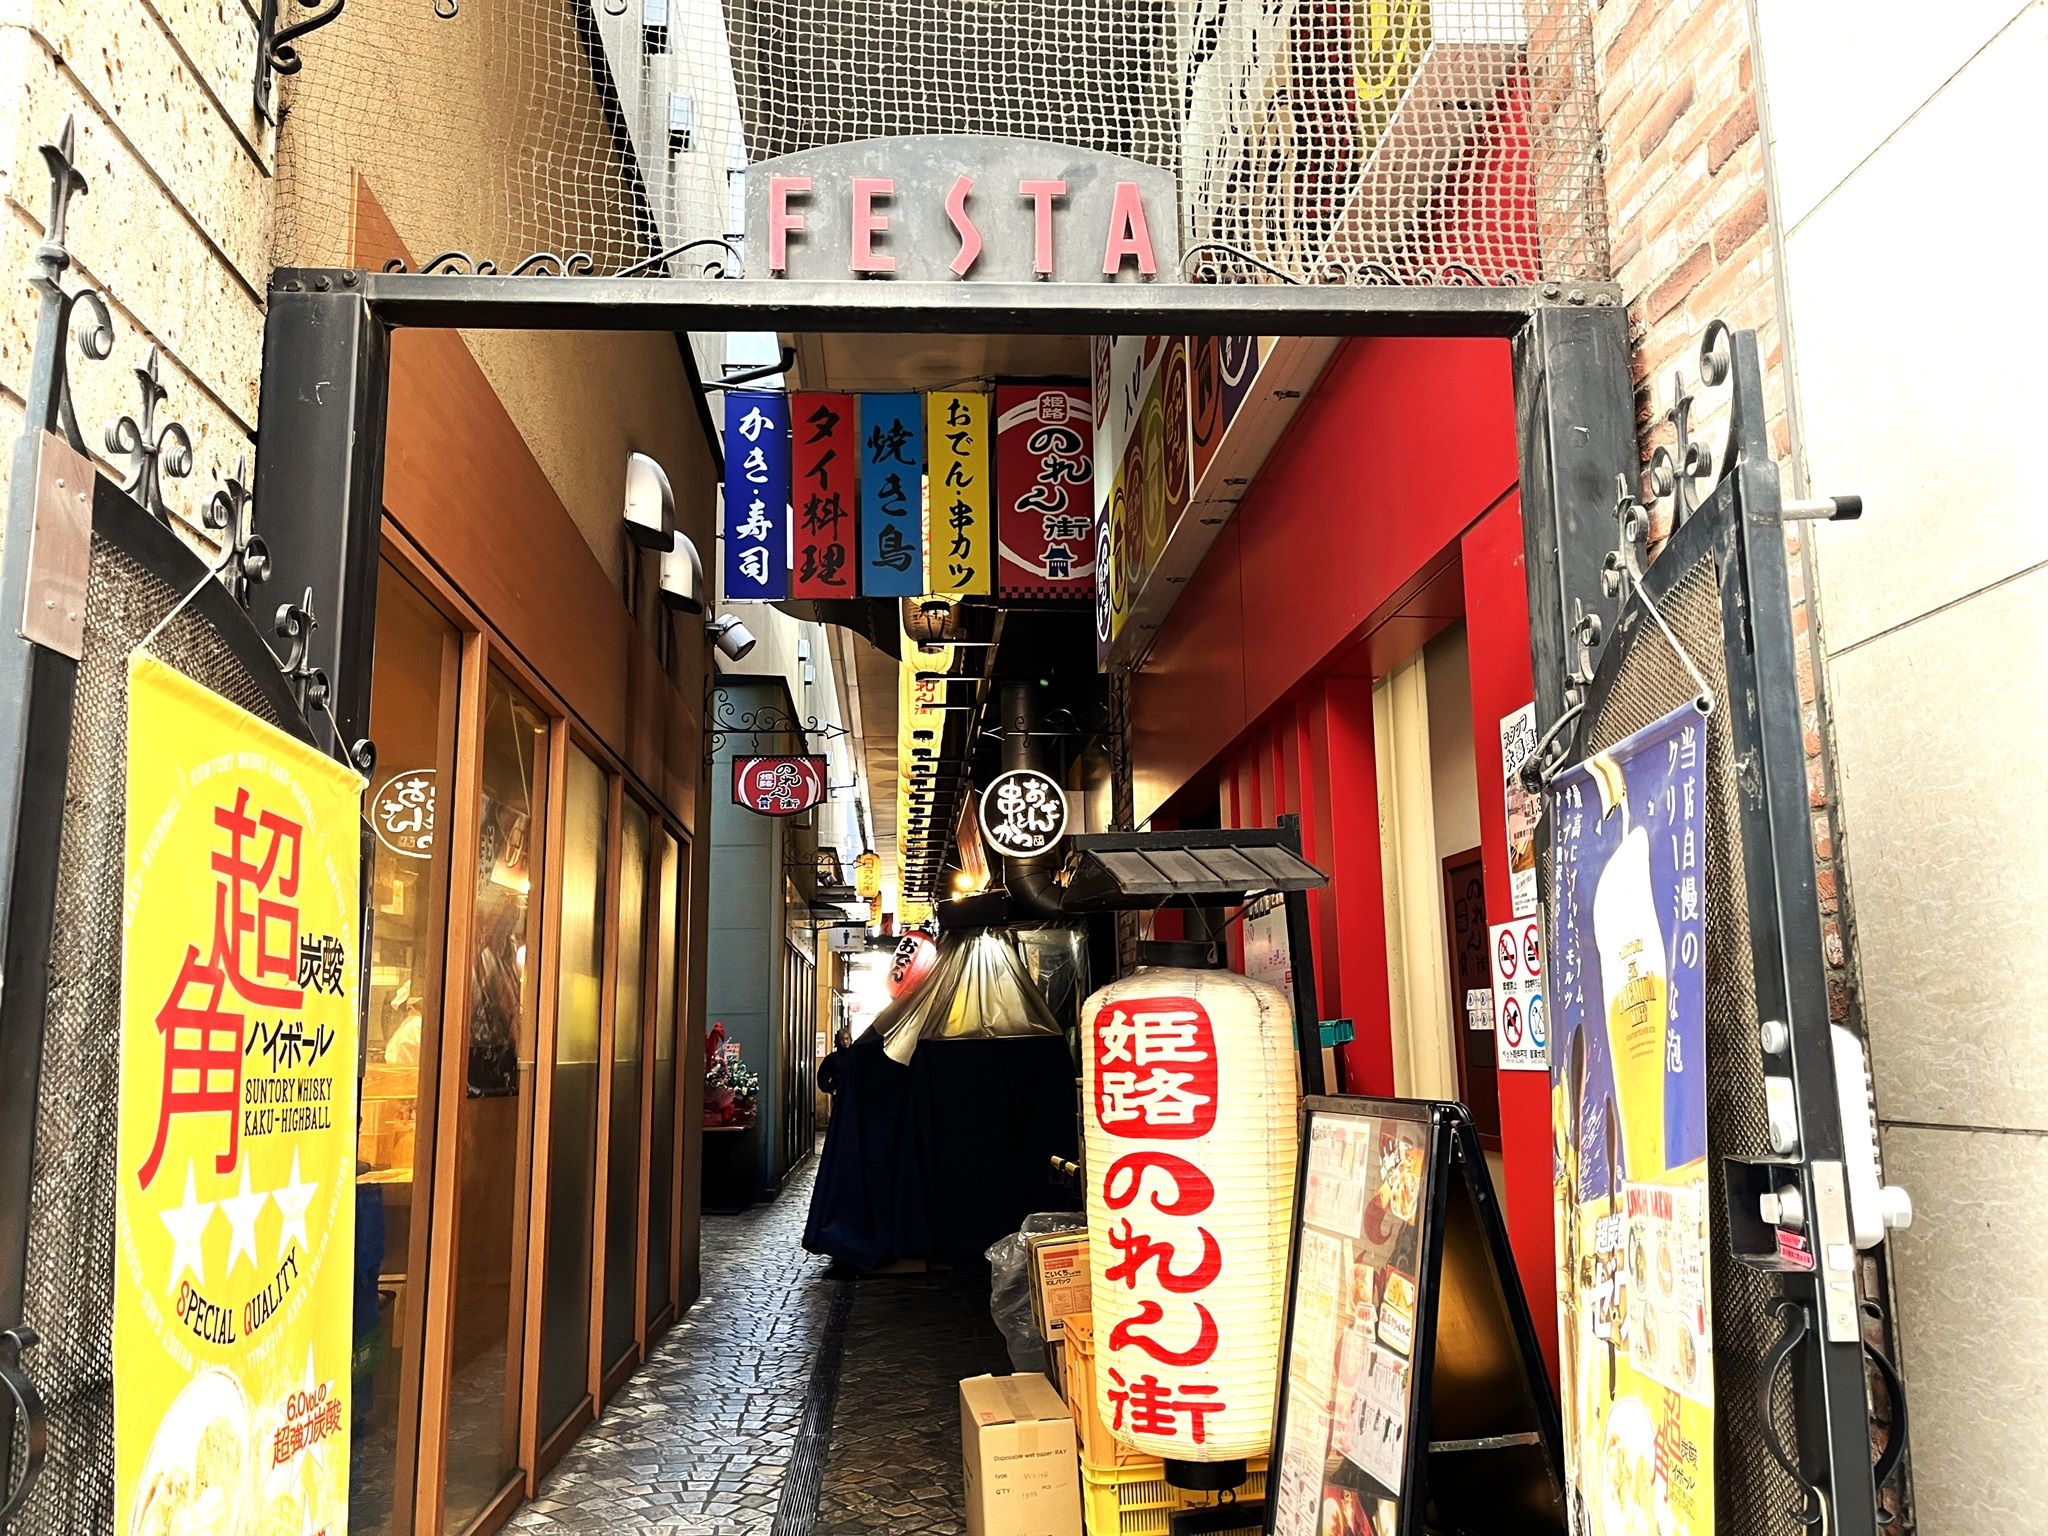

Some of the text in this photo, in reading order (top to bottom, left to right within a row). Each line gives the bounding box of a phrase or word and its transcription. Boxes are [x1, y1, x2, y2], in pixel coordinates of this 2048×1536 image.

[768, 174, 1157, 277] FESTA
[1041, 396, 1066, 420] 姫路
[736, 406, 774, 585] かき・寿司
[799, 405, 848, 587] タイ料理
[866, 424, 917, 572] 焼き鳥
[944, 397, 977, 589] おでん・串カツ
[1014, 425, 1094, 542] のれん街
[1503, 713, 1528, 750] スタッフ
[768, 762, 803, 809] のれん街
[1679, 725, 1699, 971] 当店自慢の
[1664, 739, 1685, 1075] クリーミーな泡
[297, 932, 345, 998] 炭酸
[244, 1018, 335, 1074] ハイボール
[244, 1077, 333, 1105] SUNTORY WHISKY
[1100, 1009, 1211, 1125] 姫路
[243, 1106, 331, 1137] KAKU-HIGHBALL
[176, 1280, 236, 1345] SPECIAL
[243, 1246, 299, 1337] QUALITY
[1103, 1151, 1227, 1445] のれん街
[271, 1397, 342, 1471] 超強力炭酸
